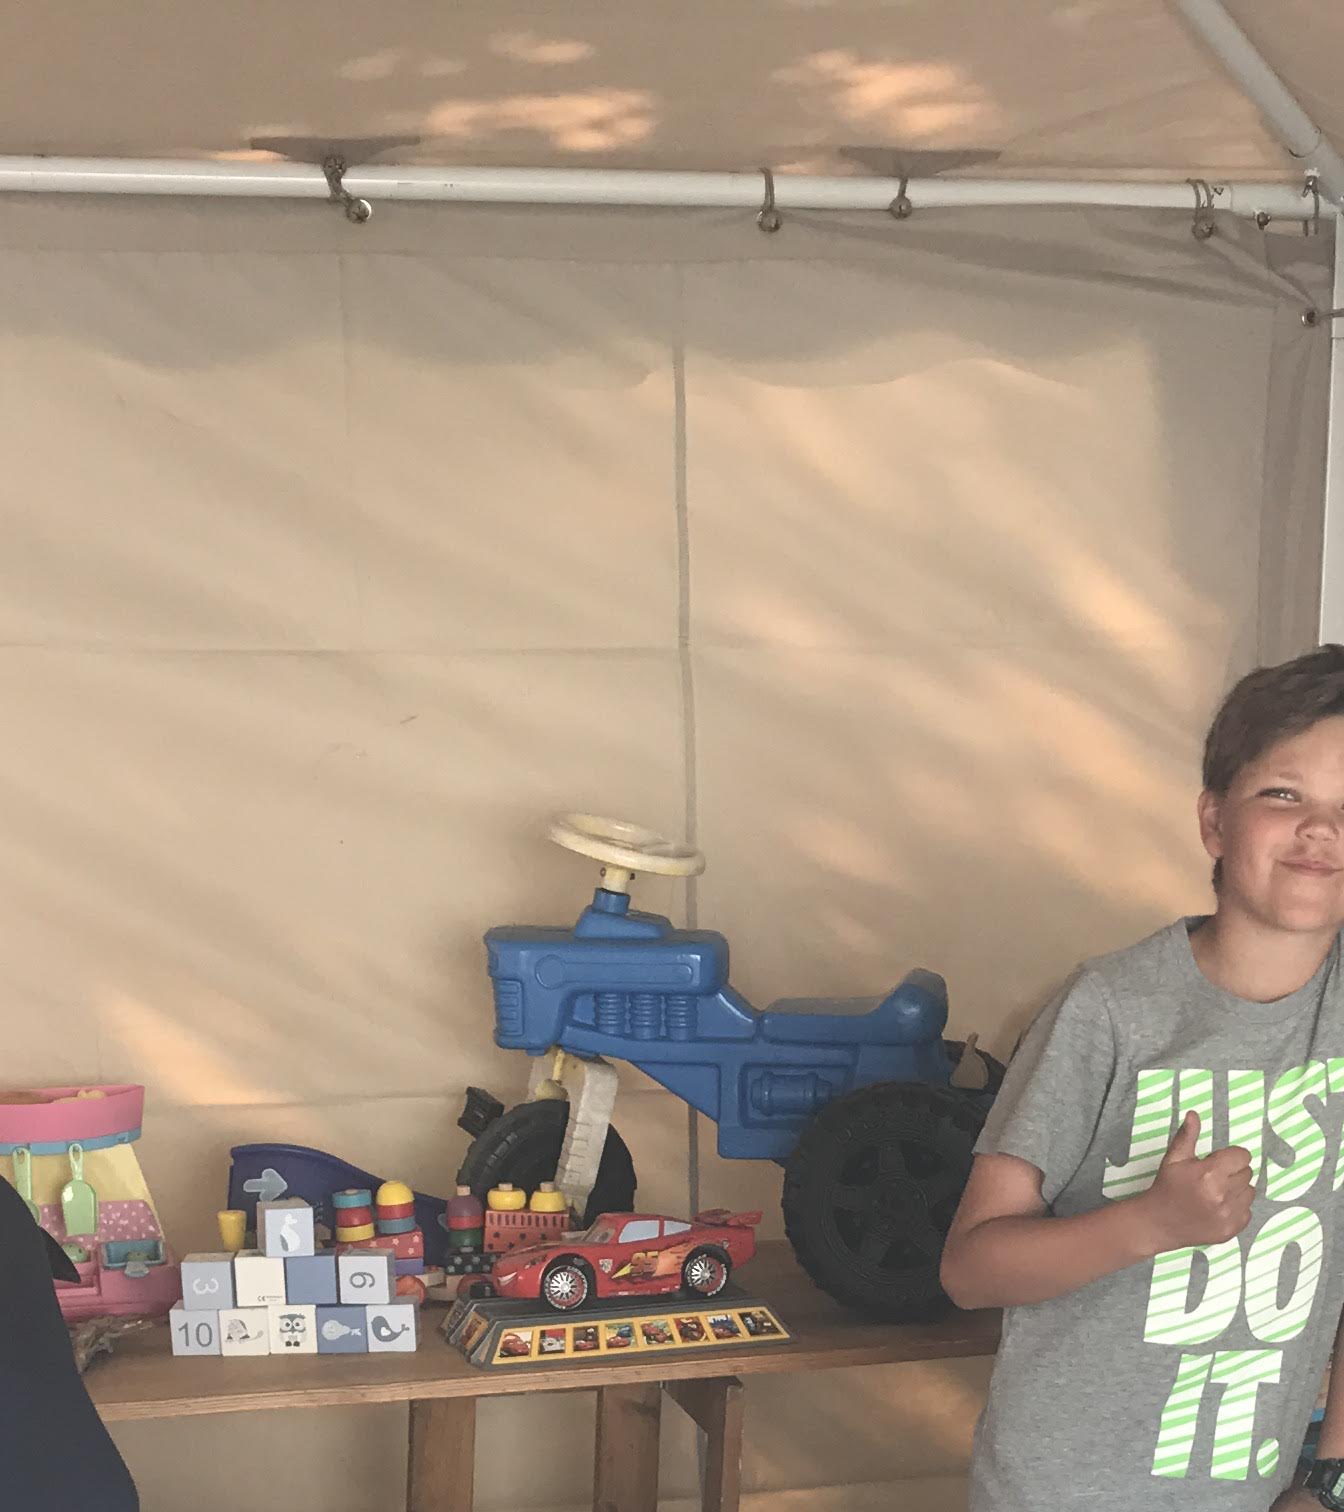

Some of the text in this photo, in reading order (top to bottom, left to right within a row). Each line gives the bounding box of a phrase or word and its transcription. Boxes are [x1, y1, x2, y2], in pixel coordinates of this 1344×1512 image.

[177, 1322, 214, 1348] 10
[1143, 1205, 1324, 1346] DO
[1150, 1349, 1284, 1481] IT.
